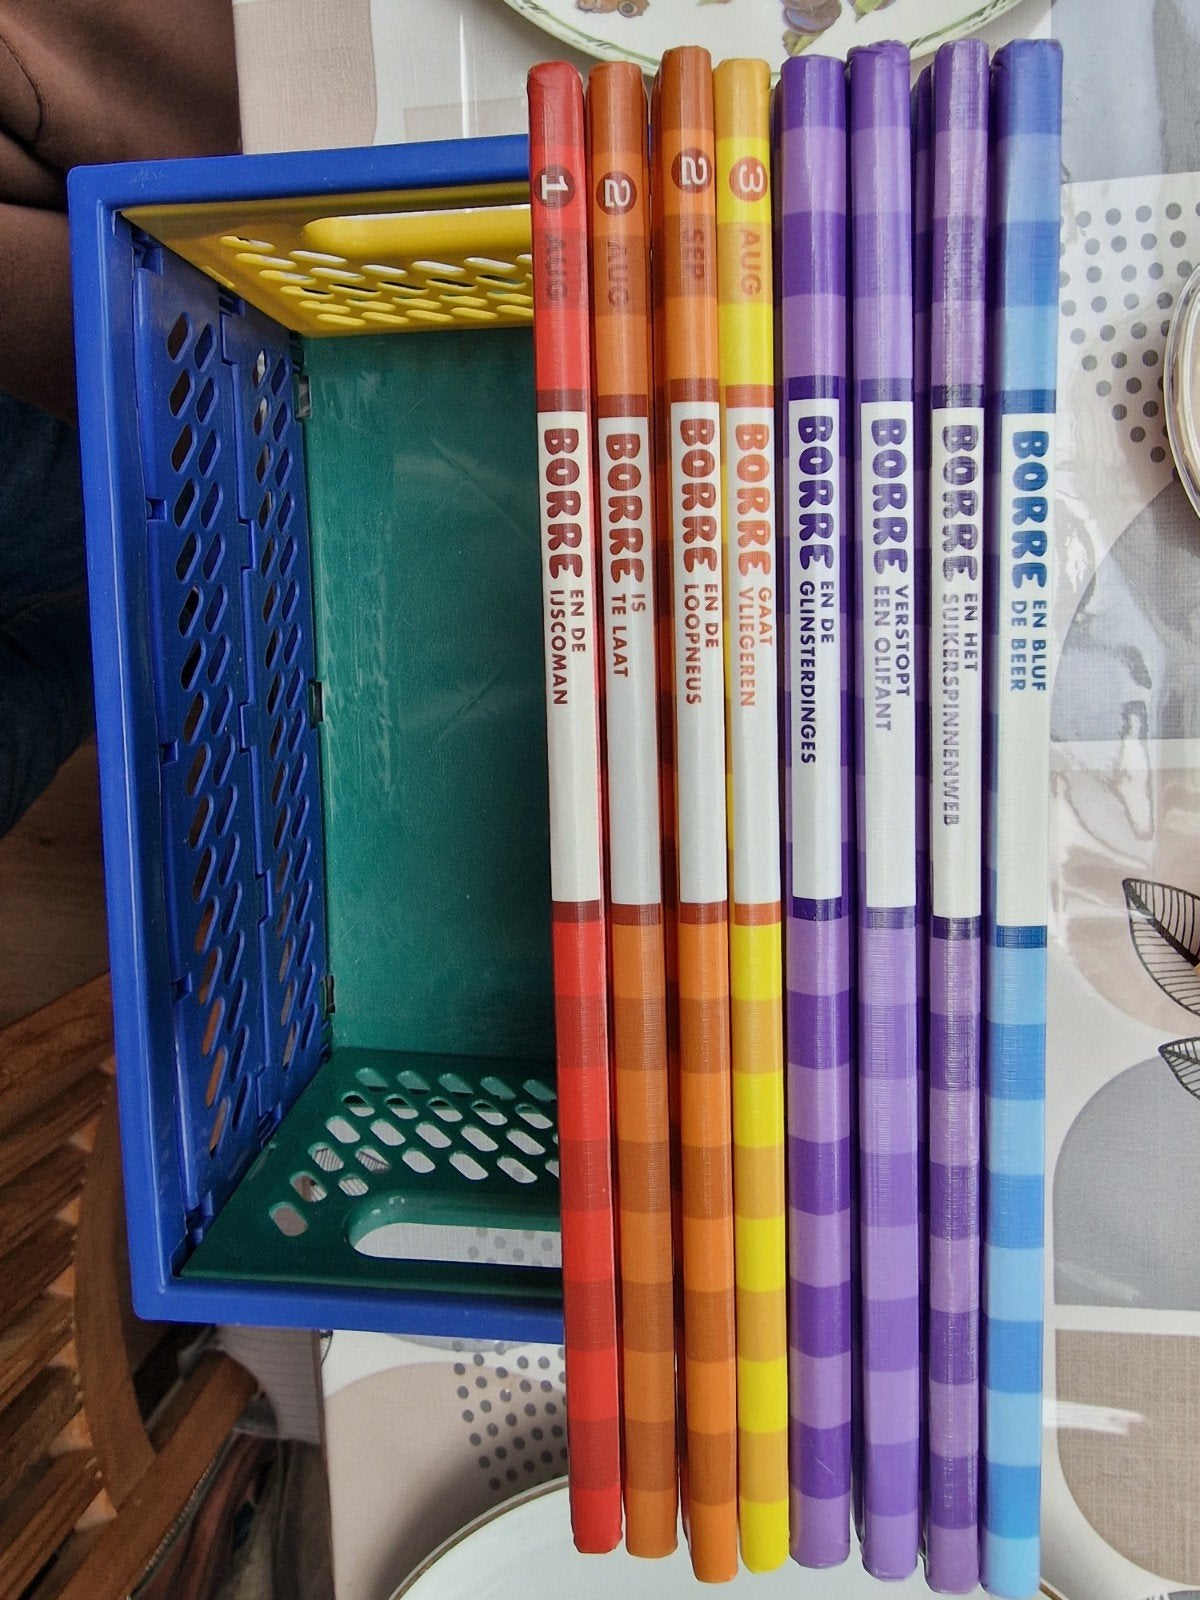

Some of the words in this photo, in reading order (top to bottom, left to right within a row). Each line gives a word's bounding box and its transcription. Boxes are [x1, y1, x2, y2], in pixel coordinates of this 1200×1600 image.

[539, 175, 569, 201] 1
[604, 179, 631, 208] 2
[681, 156, 708, 185] 2
[738, 163, 764, 193] 3
[544, 428, 584, 580] BORRE
[605, 433, 645, 583] BORRE
[680, 418, 718, 573] BORRE
[735, 423, 771, 577] BORRE
[797, 416, 834, 570] BORRE
[871, 418, 909, 575] BORRE
[942, 425, 979, 583] BORRE
[1012, 430, 1049, 588] BORRE
[570, 589, 584, 617] EN
[611, 593, 627, 615] TE
[631, 593, 645, 613] IS
[704, 584, 718, 612] EN
[759, 587, 773, 646] GAAT
[820, 581, 834, 608] EN
[874, 586, 890, 627] EEN
[964, 593, 978, 621] EN
[1011, 601, 1027, 627] DE
[1032, 600, 1047, 628] EN
[550, 590, 568, 706] IJSCOMAN
[571, 628, 586, 653] DE
[612, 626, 629, 677] LAAT
[684, 584, 702, 706] LOOPNEUS
[705, 623, 719, 649] DE
[739, 588, 755, 707] VLIEGEREN
[821, 618, 834, 644] DE
[895, 585, 910, 697] VERSTOPT
[964, 632, 978, 672] HET
[800, 581, 816, 764] GLINSTERDINGES
[874, 637, 891, 732] OLIFANT
[1010, 638, 1026, 692] BEER
[1031, 640, 1046, 691] BLUF
[942, 594, 960, 827] SUIKERSPINNENWEB
